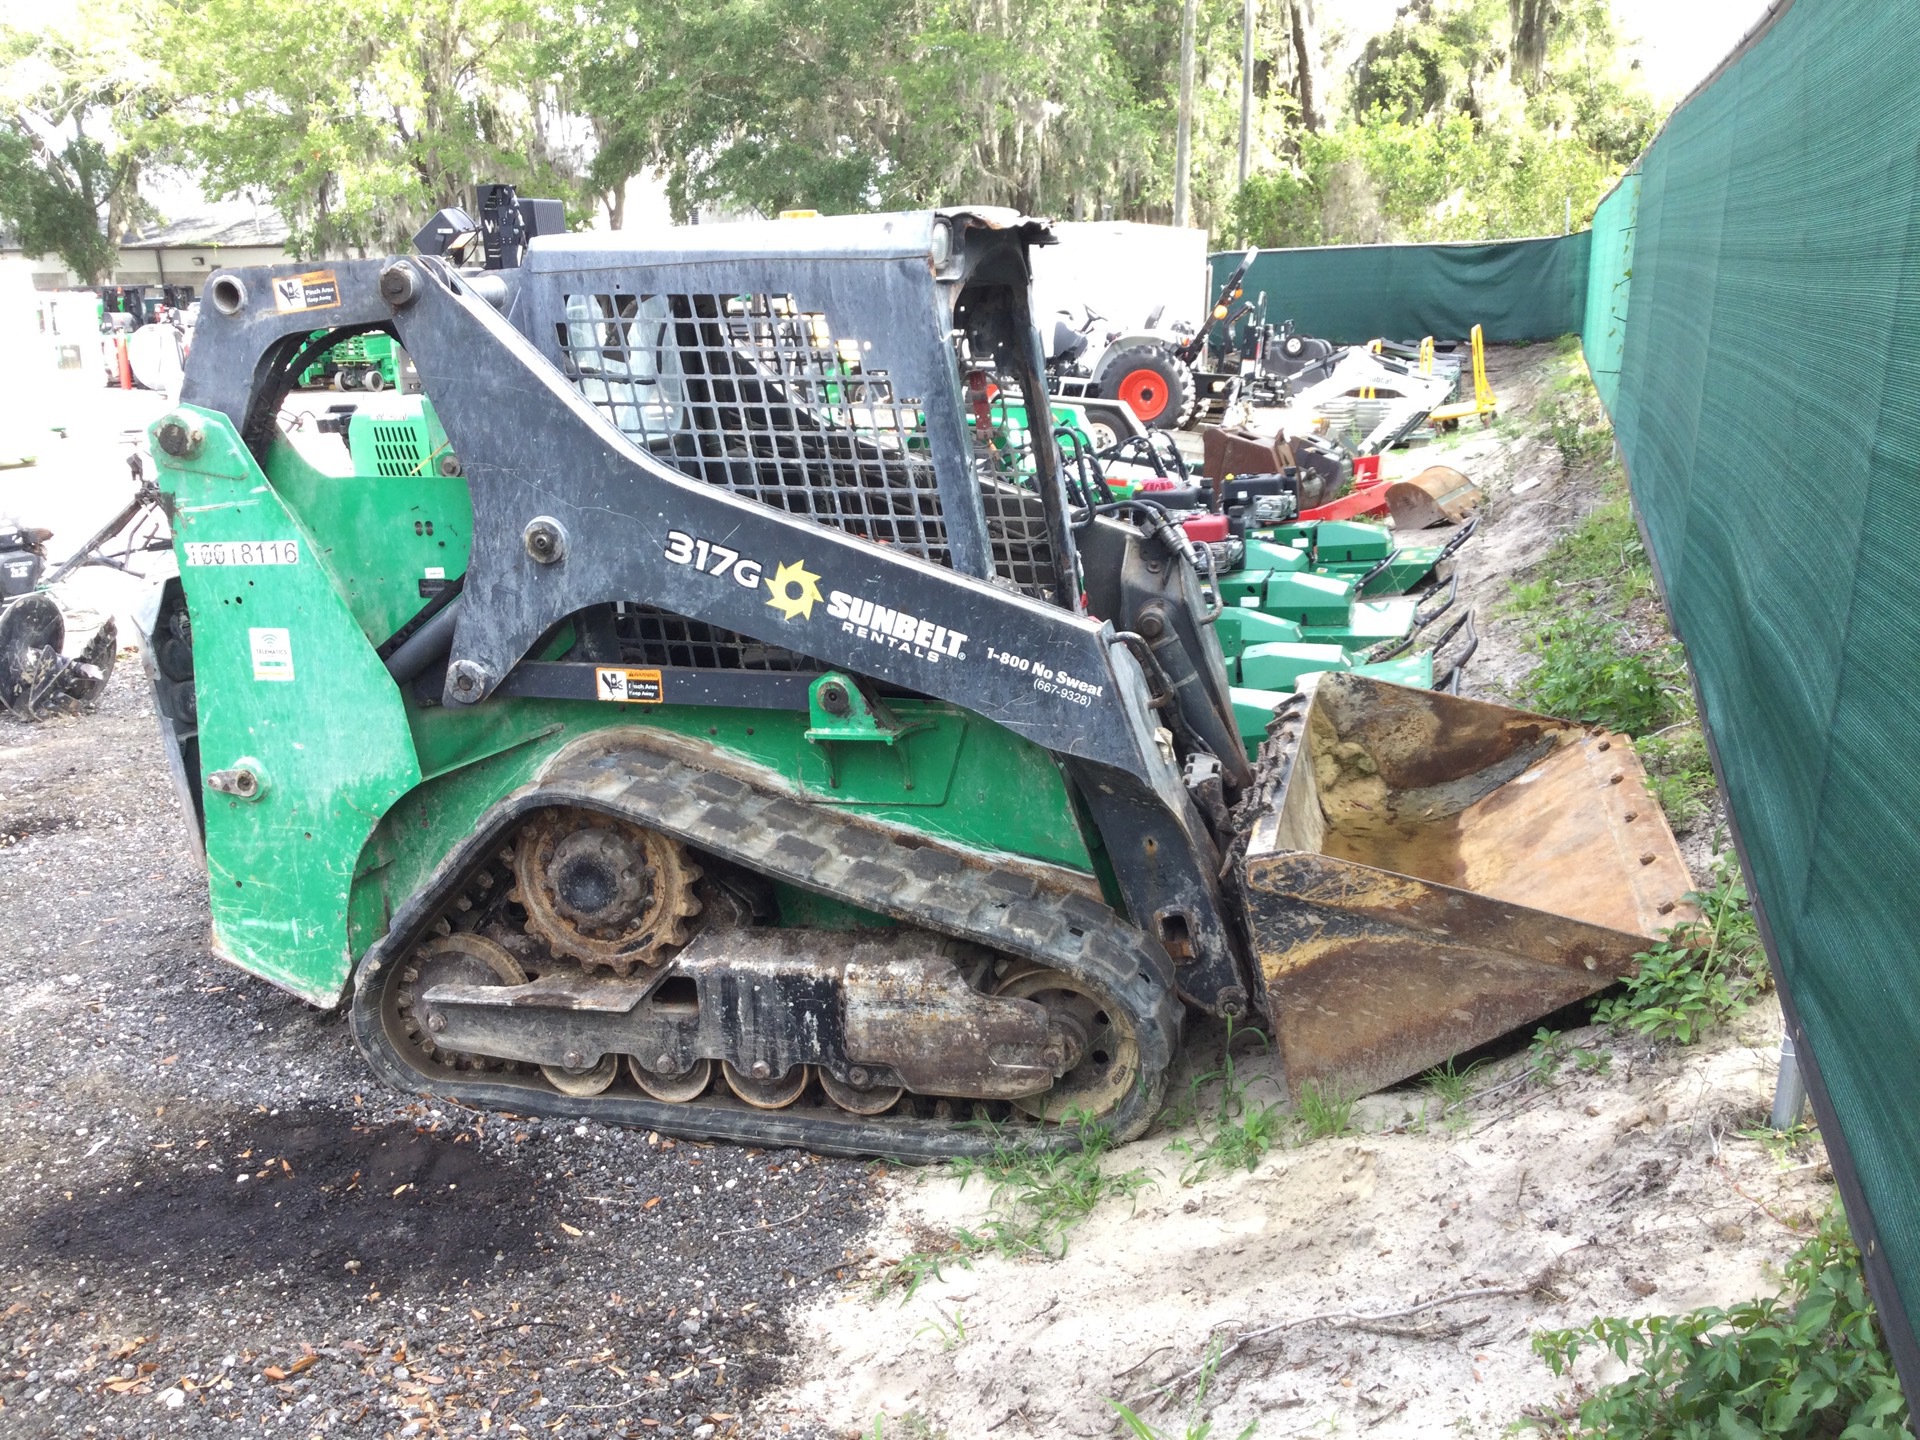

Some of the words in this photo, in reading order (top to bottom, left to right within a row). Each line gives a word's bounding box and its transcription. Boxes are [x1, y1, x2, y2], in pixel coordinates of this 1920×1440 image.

[305, 288, 320, 296] Pinch
[664, 531, 763, 588] 317G
[826, 590, 968, 658] SUNBELT
[841, 621, 940, 663] RENTALS
[987, 647, 1029, 671] 1-800
[1031, 661, 1054, 680] No
[1055, 671, 1104, 697] Sweat
[1033, 678, 1092, 708] (667-9328)
